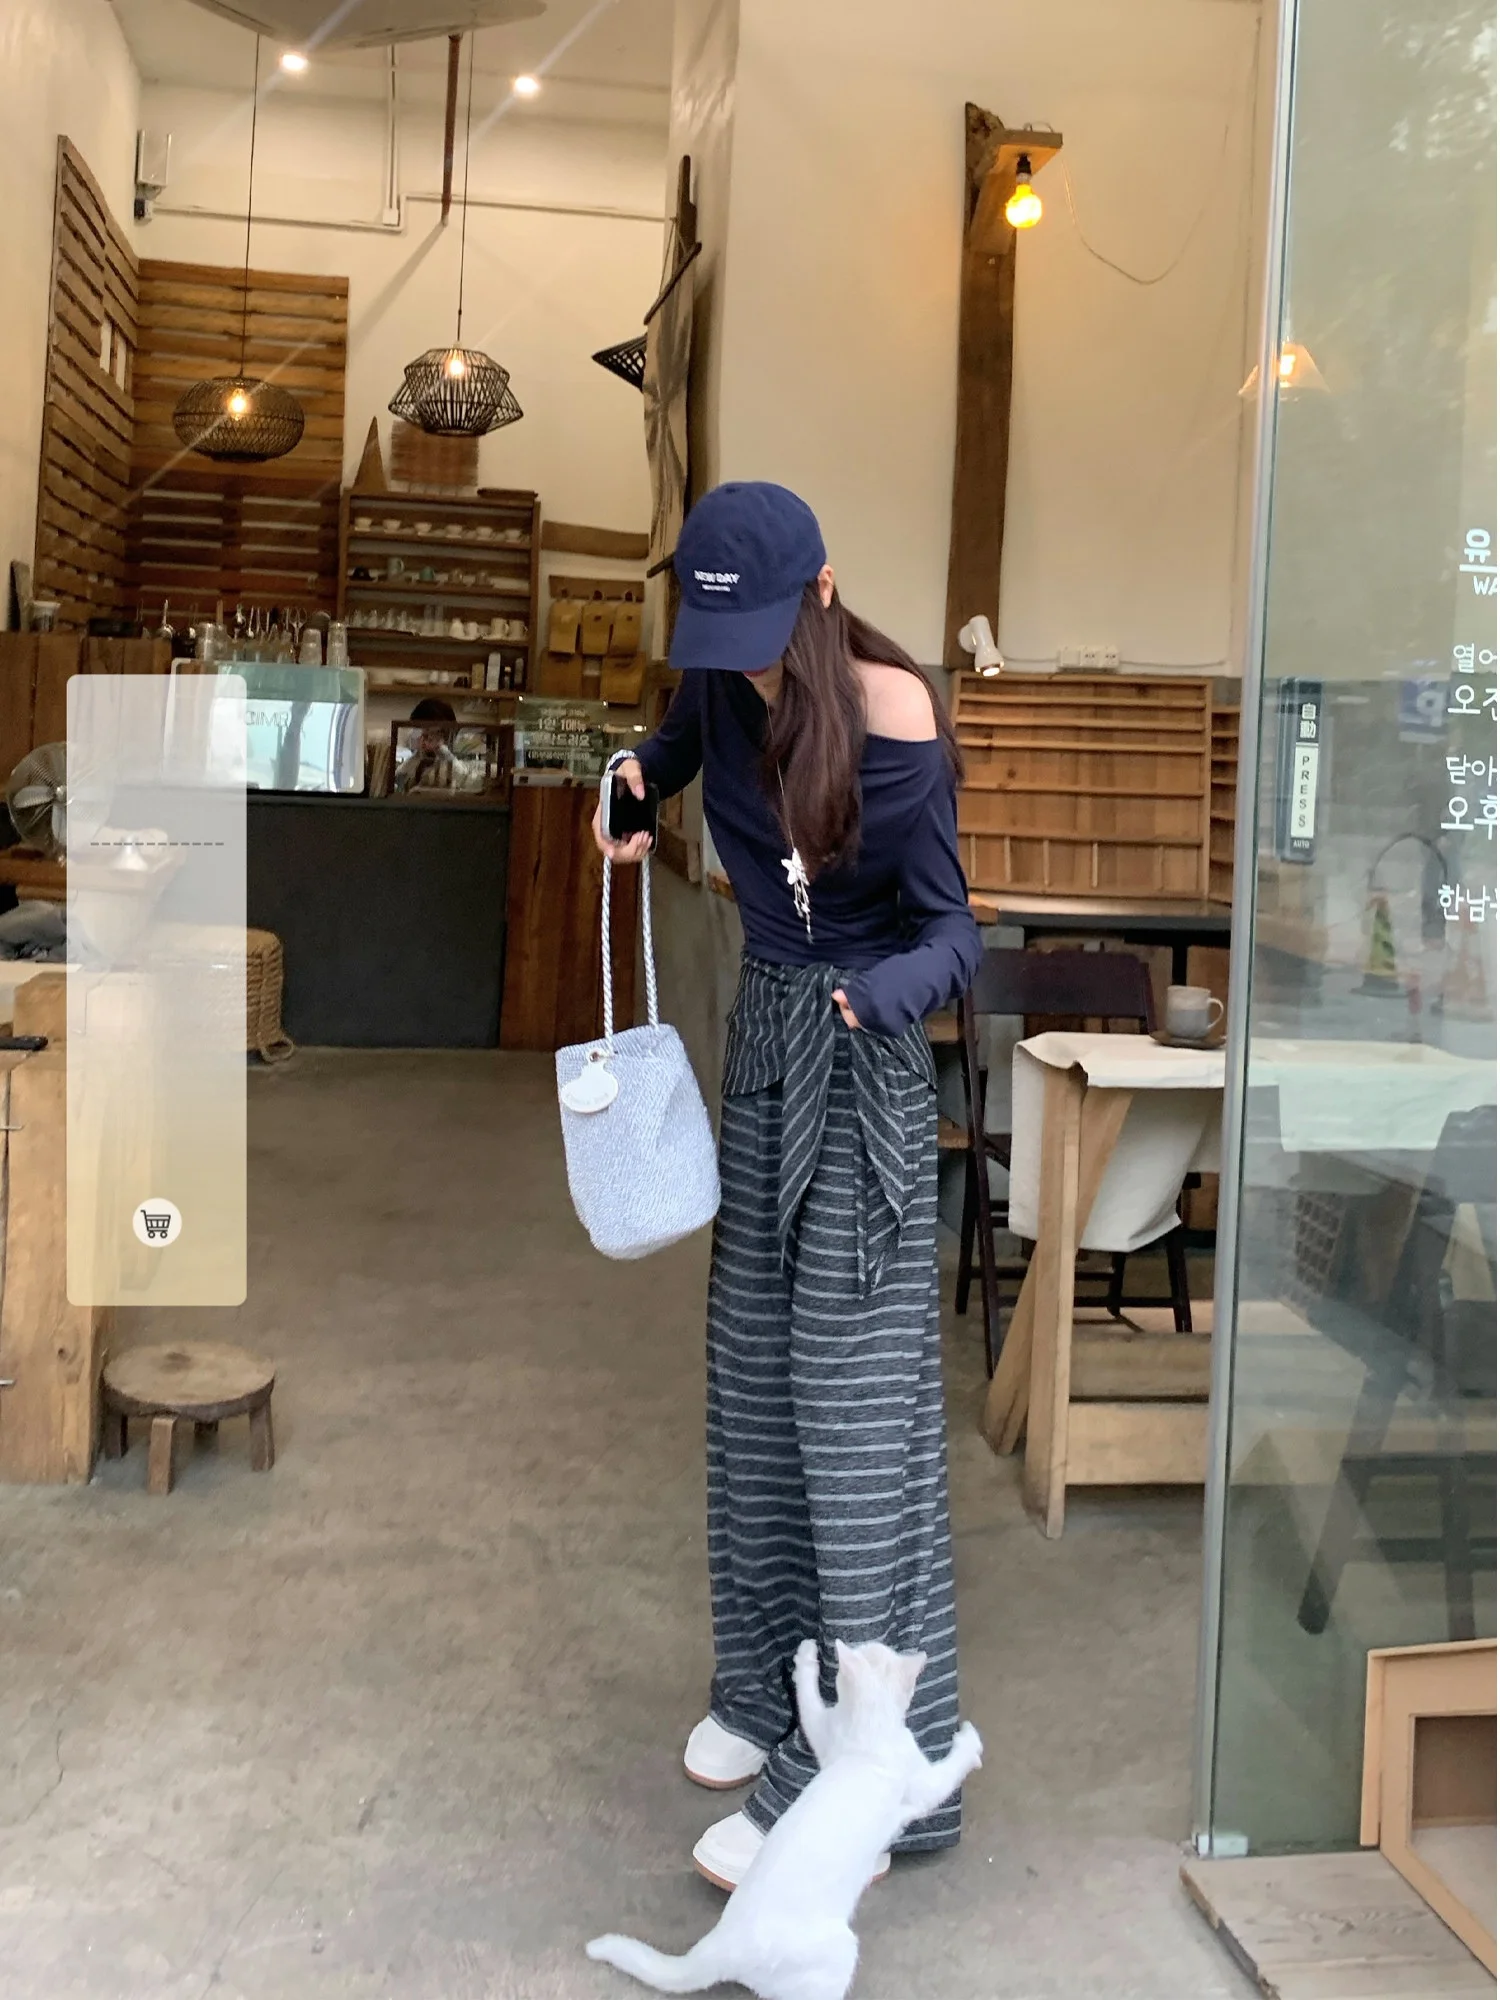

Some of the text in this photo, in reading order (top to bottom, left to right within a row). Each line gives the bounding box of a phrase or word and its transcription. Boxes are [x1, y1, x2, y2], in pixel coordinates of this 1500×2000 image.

[1298, 755, 1310, 829] PRESS
[1293, 839, 1310, 849] AUTO
[1438, 883, 1497, 922] 한남
